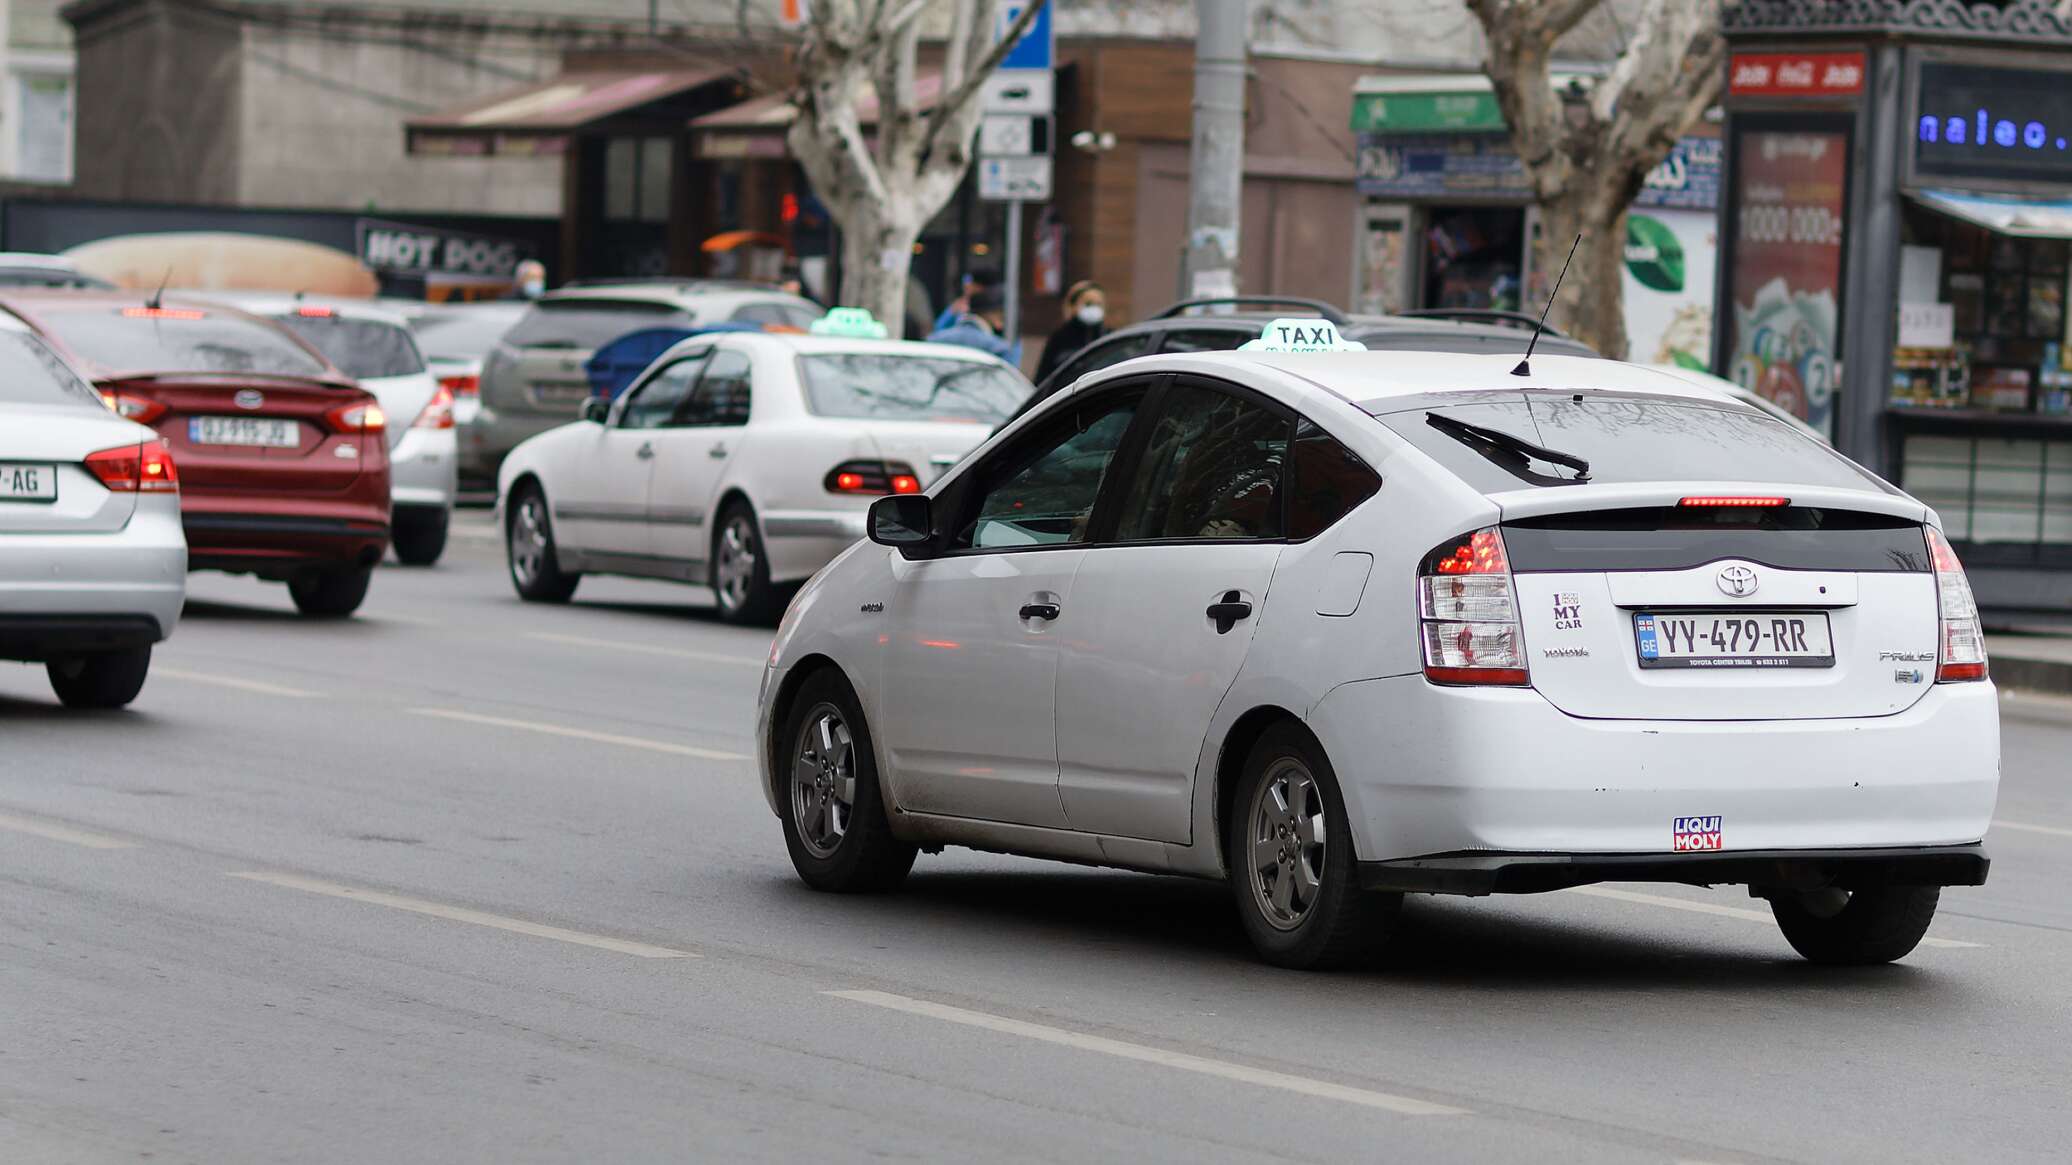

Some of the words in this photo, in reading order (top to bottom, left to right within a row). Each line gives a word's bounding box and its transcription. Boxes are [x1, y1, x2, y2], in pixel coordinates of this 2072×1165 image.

[368, 230, 438, 269] HOT
[446, 239, 516, 274] DOG
[1277, 327, 1334, 345] TAXI
[0, 469, 38, 491] -AG
[1553, 593, 1561, 606] I
[1553, 605, 1581, 620] MY
[1555, 619, 1582, 630] CAR
[1661, 619, 1808, 653] YY-479-RR
[1641, 639, 1657, 651] GE
[1675, 817, 1720, 833] LIQUI
[1675, 833, 1721, 850] MOLY
